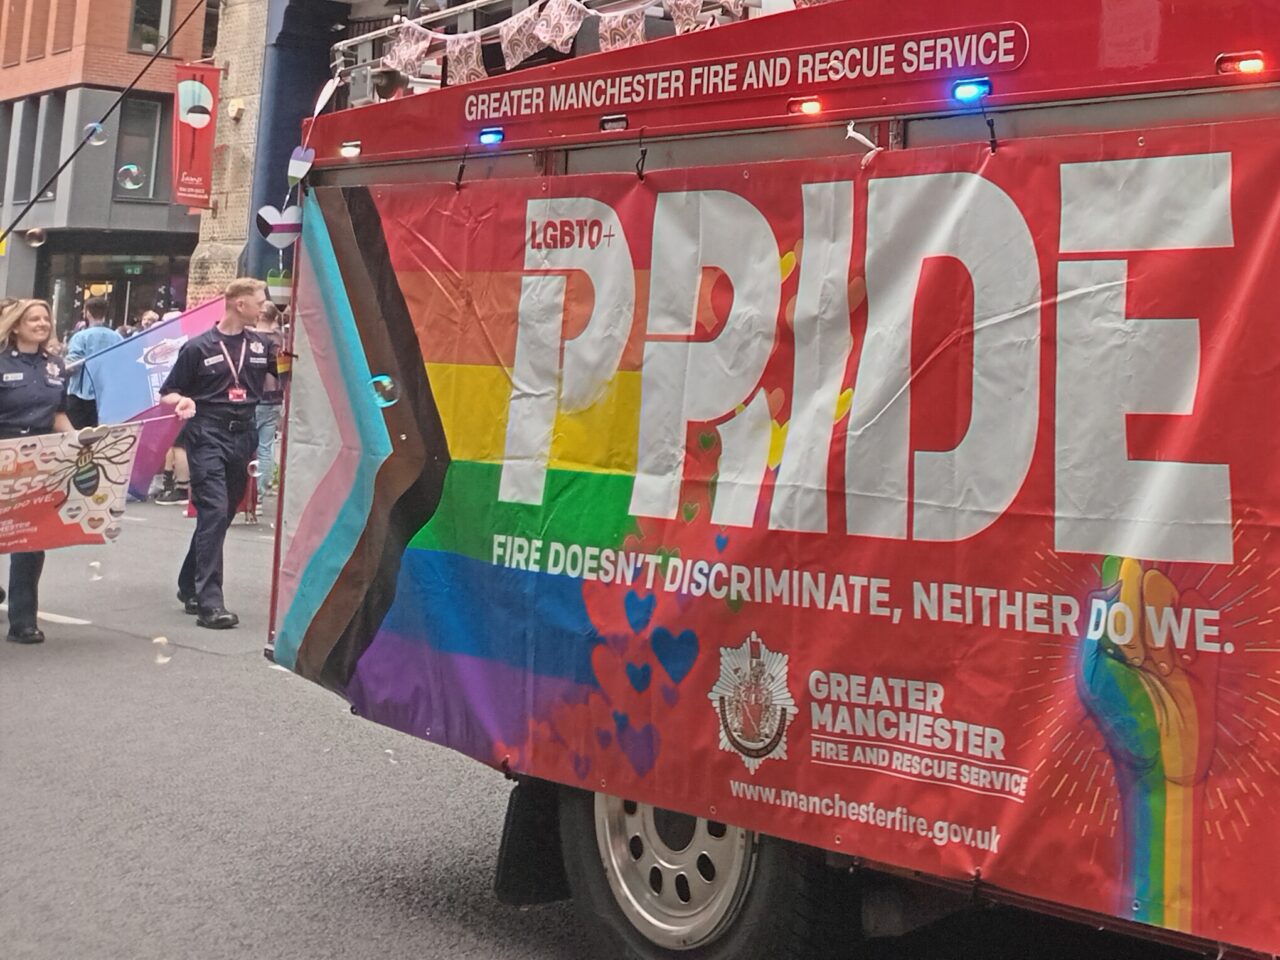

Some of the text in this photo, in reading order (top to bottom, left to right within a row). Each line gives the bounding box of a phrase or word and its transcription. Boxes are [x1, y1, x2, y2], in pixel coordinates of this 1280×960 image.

[464, 29, 1015, 121] GREATER MANCHESTER FIRE AND RESCUE SERVICE
[498, 151, 1236, 565] PRIDE
[492, 535, 1235, 654] FIRE DOESN'T DISCRIMINATE, NEITHER DO WE.
[808, 669, 945, 714] GREATER
[810, 702, 1005, 760] MANCHESTER
[811, 742, 1028, 796] FIRE AND RESCUE SERVICE
[729, 777, 1001, 854] www.manchesterfire.gov.uk
